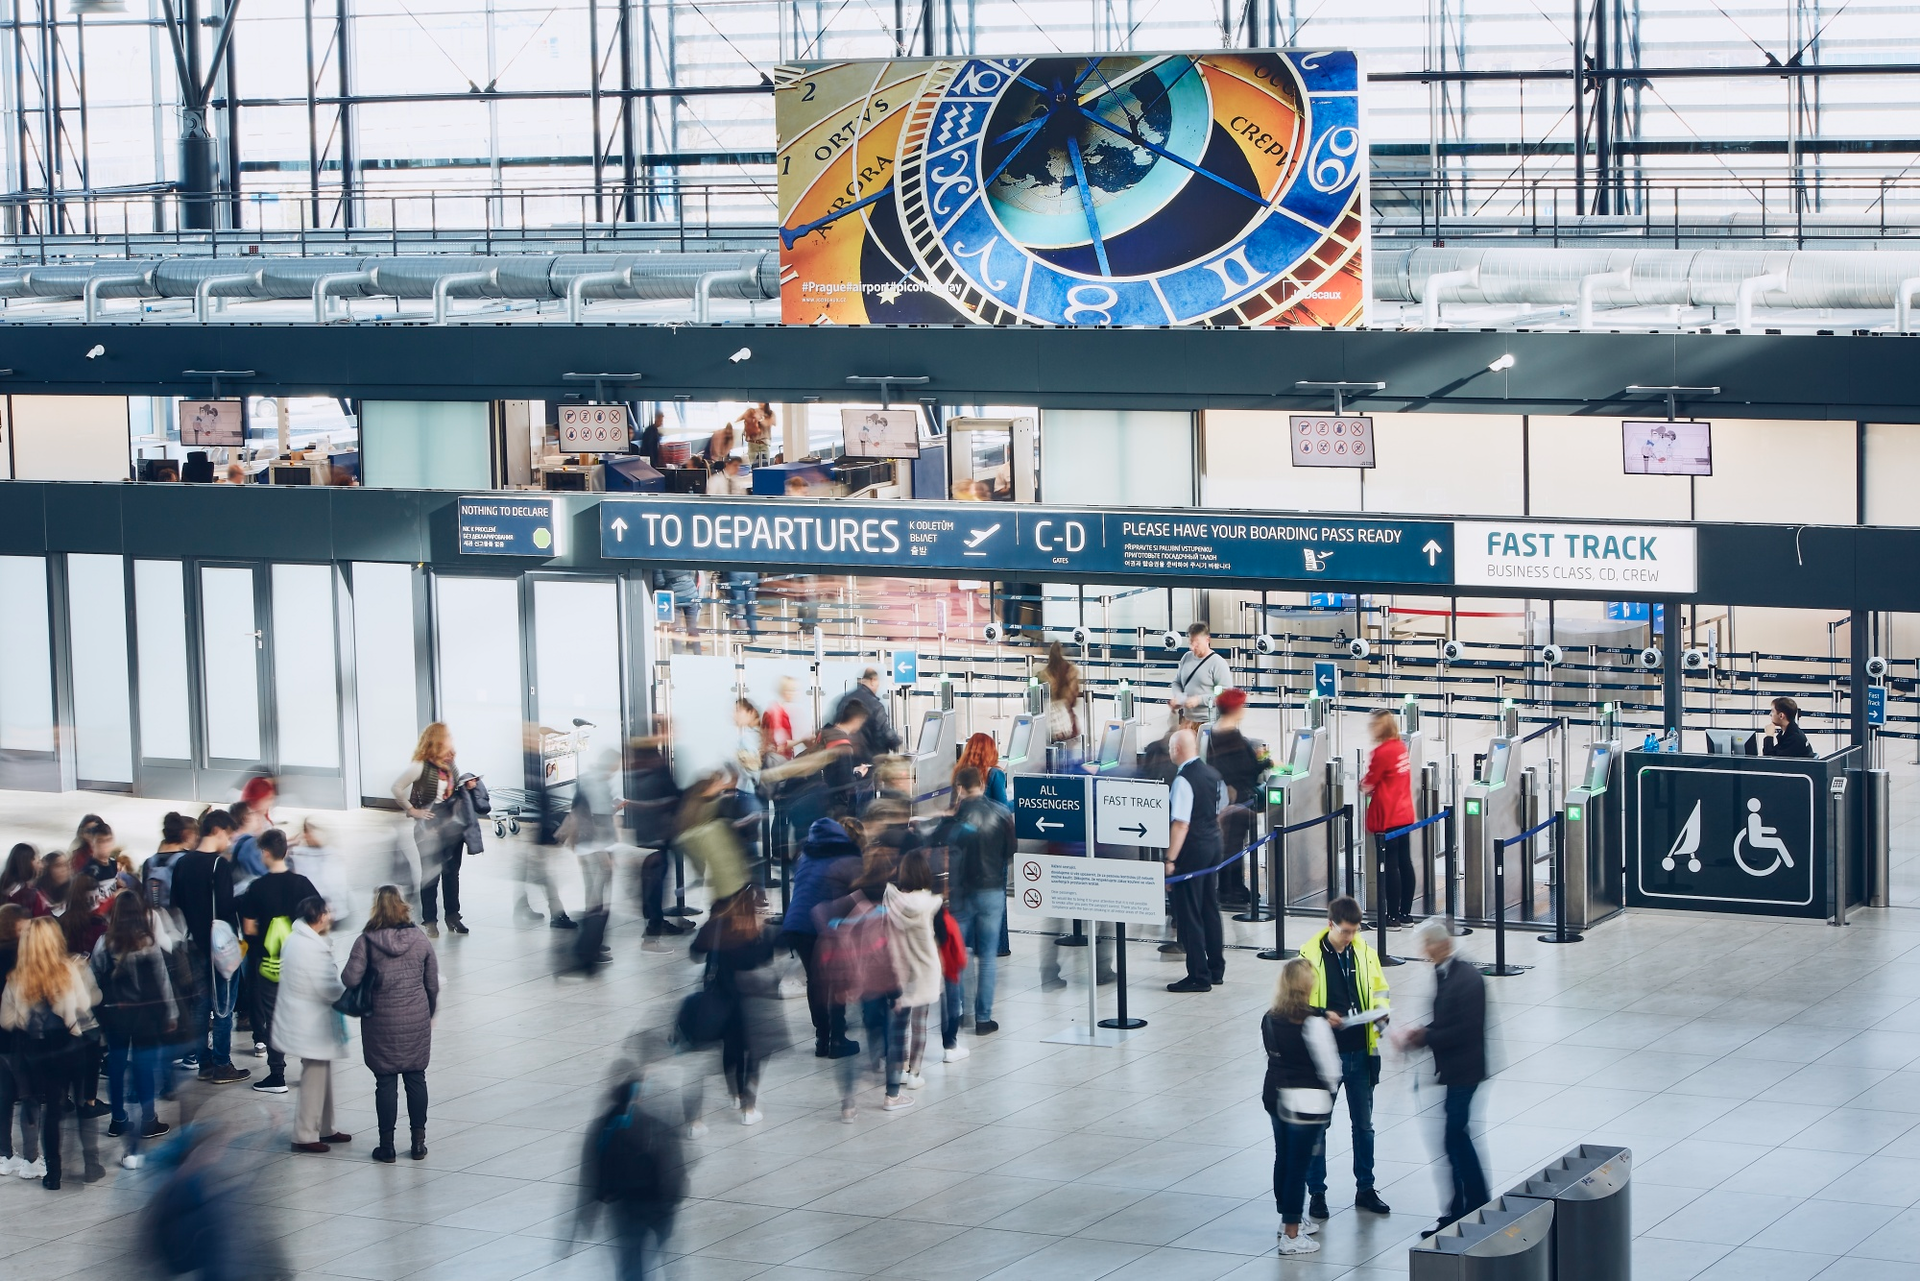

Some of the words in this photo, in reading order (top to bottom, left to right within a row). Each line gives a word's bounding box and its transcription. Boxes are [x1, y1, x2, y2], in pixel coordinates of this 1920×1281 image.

[801, 82, 816, 102] 2
[782, 156, 791, 175] 1
[461, 505, 498, 516] NOTHING
[500, 506, 510, 516] TO
[512, 507, 549, 517] DECLARE
[642, 513, 683, 547] TO
[692, 515, 899, 553] DEPARTURES
[909, 521, 915, 530] K
[916, 519, 954, 530] ODLETŮM
[1123, 522, 1170, 536] PLEASE
[1173, 523, 1208, 538] HAVE
[1211, 525, 1247, 539] YOUR
[1250, 526, 1318, 542] BOARDING
[1321, 528, 1354, 543] PASS
[1358, 529, 1402, 544] READY
[910, 534, 937, 543] ВЫЛЕТ
[1036, 520, 1085, 552] C-D
[1487, 531, 1554, 559] FAST
[1563, 532, 1658, 561] TRACK
[1487, 564, 1548, 579] BUSINESS
[1553, 566, 1595, 582] CLASS,
[1599, 567, 1619, 582] CD,
[1623, 568, 1659, 582] CREW
[1040, 785, 1058, 796] ALL
[1018, 798, 1080, 811] PASSENGERS
[1103, 795, 1127, 806] FAST
[1130, 797, 1162, 809] TRACK
